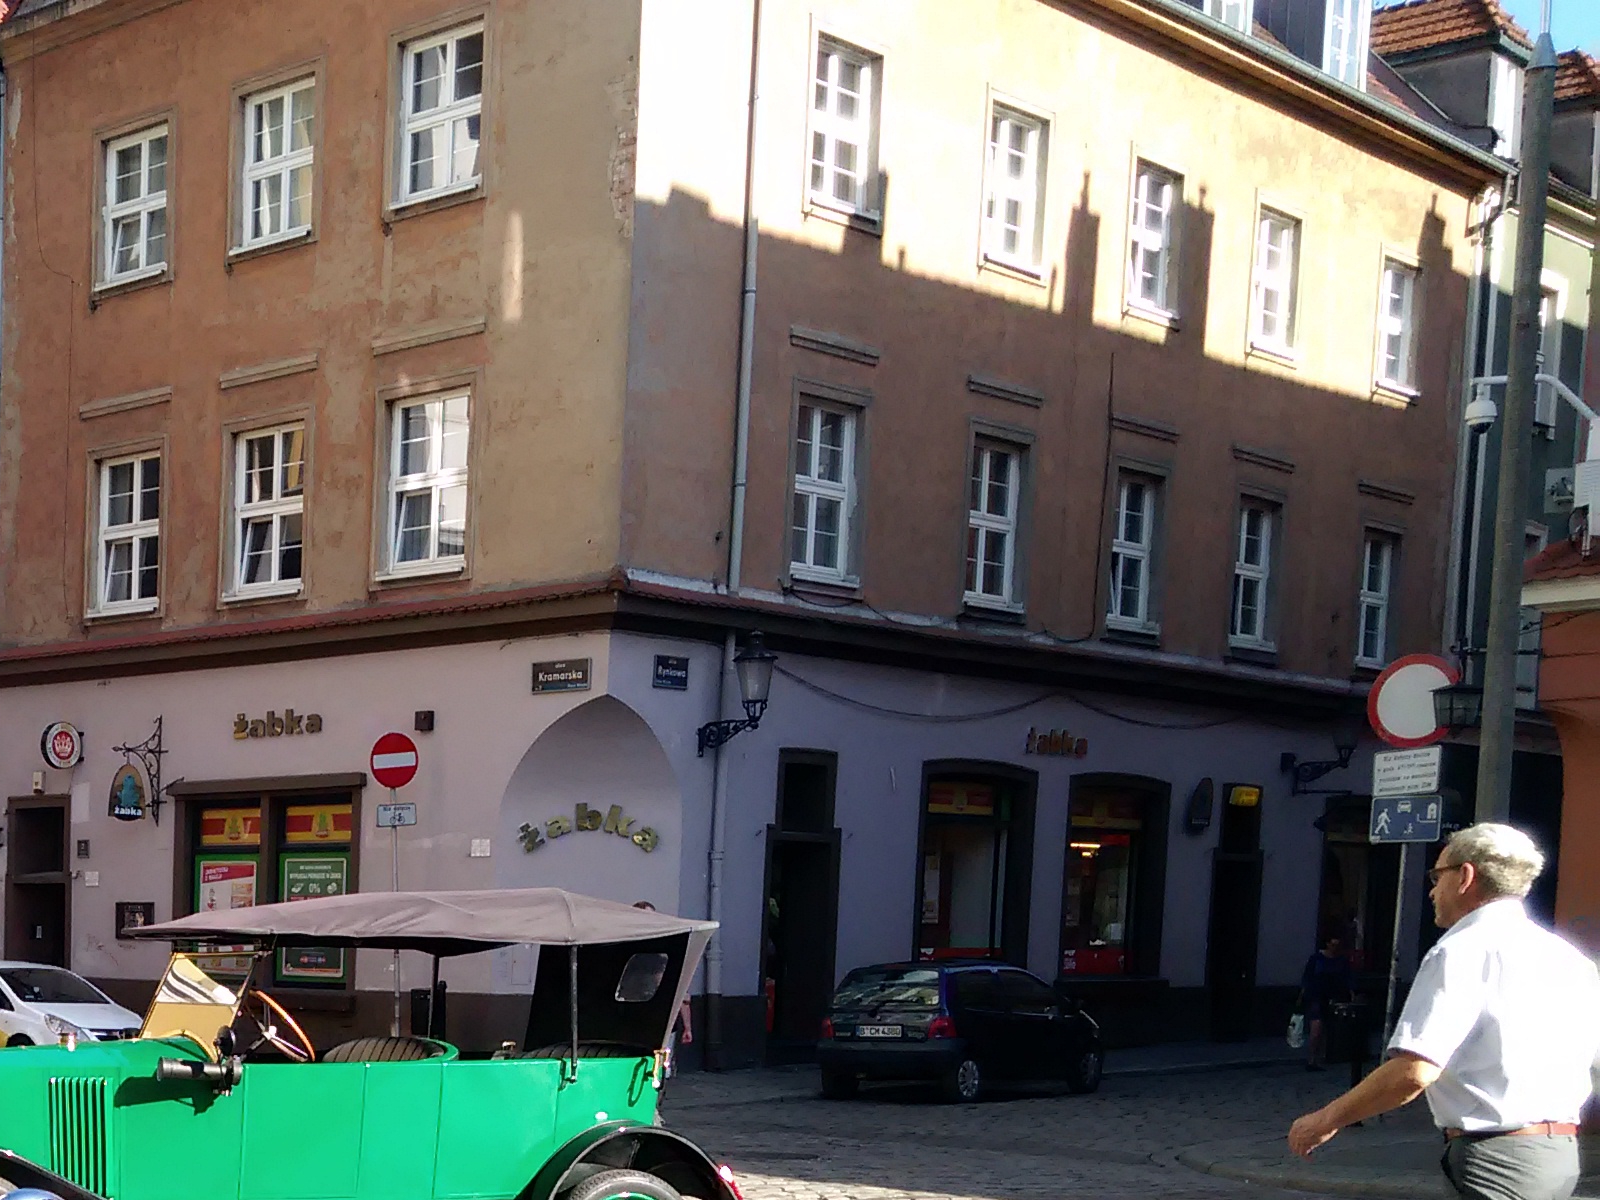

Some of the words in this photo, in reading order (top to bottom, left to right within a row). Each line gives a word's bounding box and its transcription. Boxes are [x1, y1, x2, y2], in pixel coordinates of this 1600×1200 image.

[538, 669, 583, 682] Kramarska
[658, 665, 686, 678] Rynkowa
[233, 708, 323, 739] żabka
[114, 806, 143, 816] żabka
[516, 802, 659, 854] żabka
